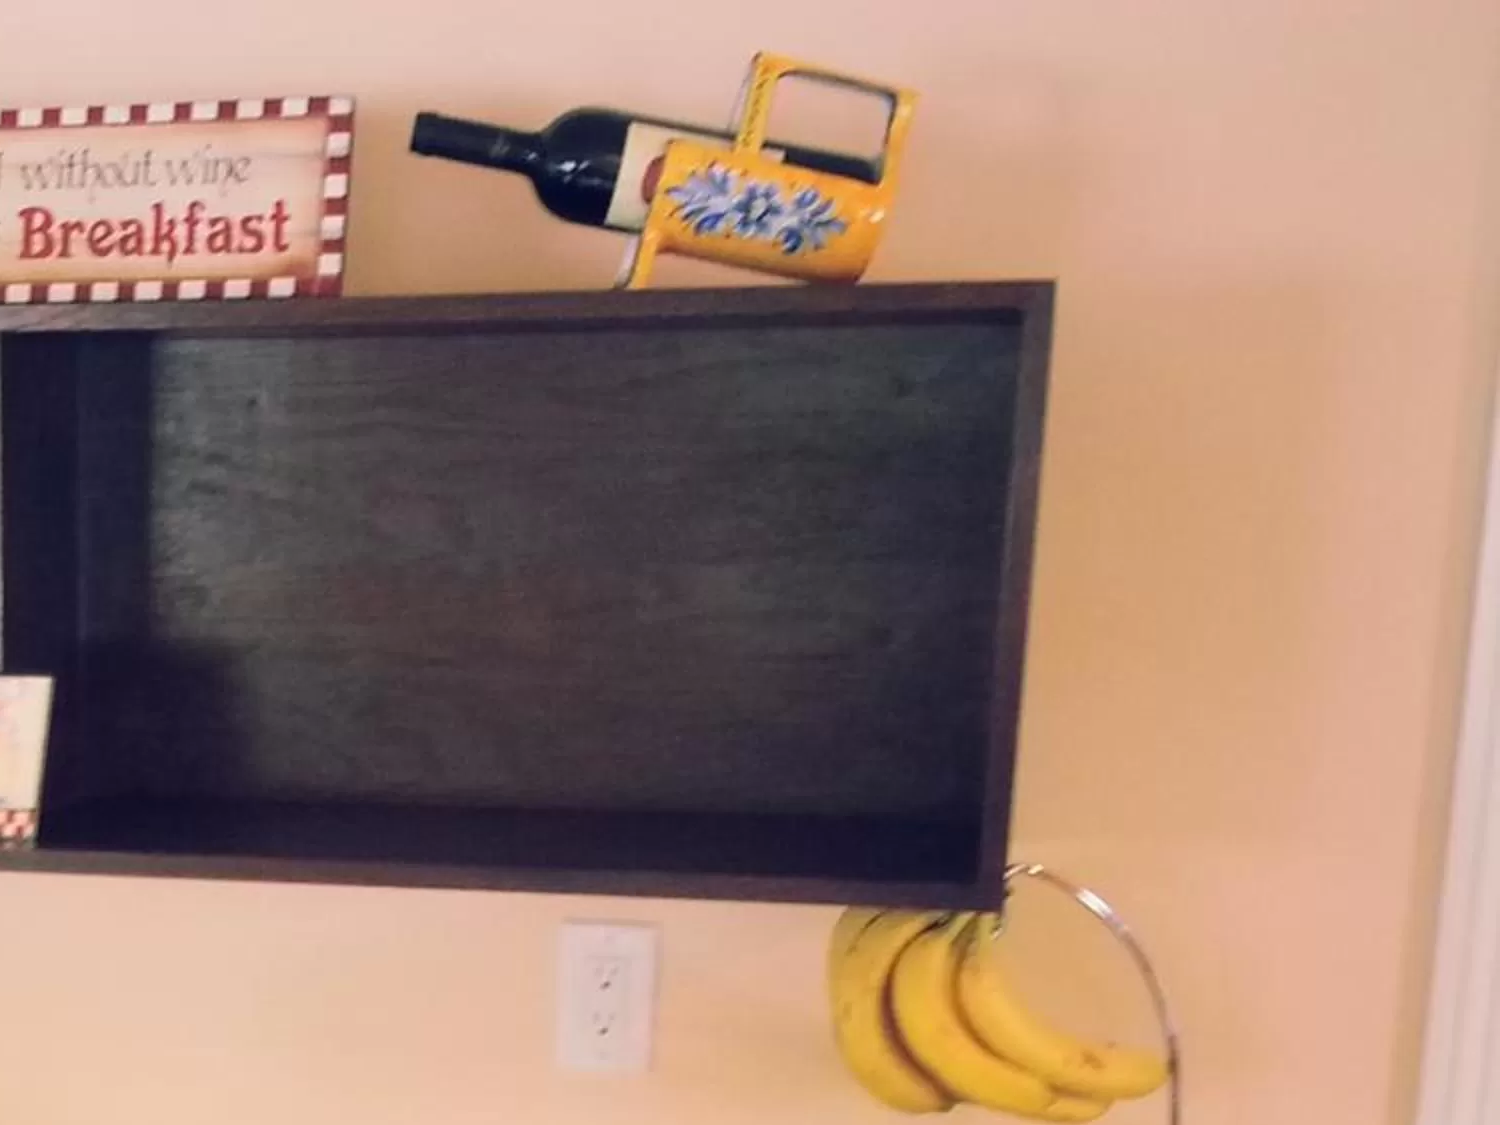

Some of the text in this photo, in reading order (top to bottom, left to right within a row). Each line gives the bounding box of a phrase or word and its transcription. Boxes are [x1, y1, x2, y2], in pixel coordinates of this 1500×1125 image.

[19, 148, 156, 202] without
[165, 145, 252, 196] wine
[17, 199, 291, 268] Breakfast
